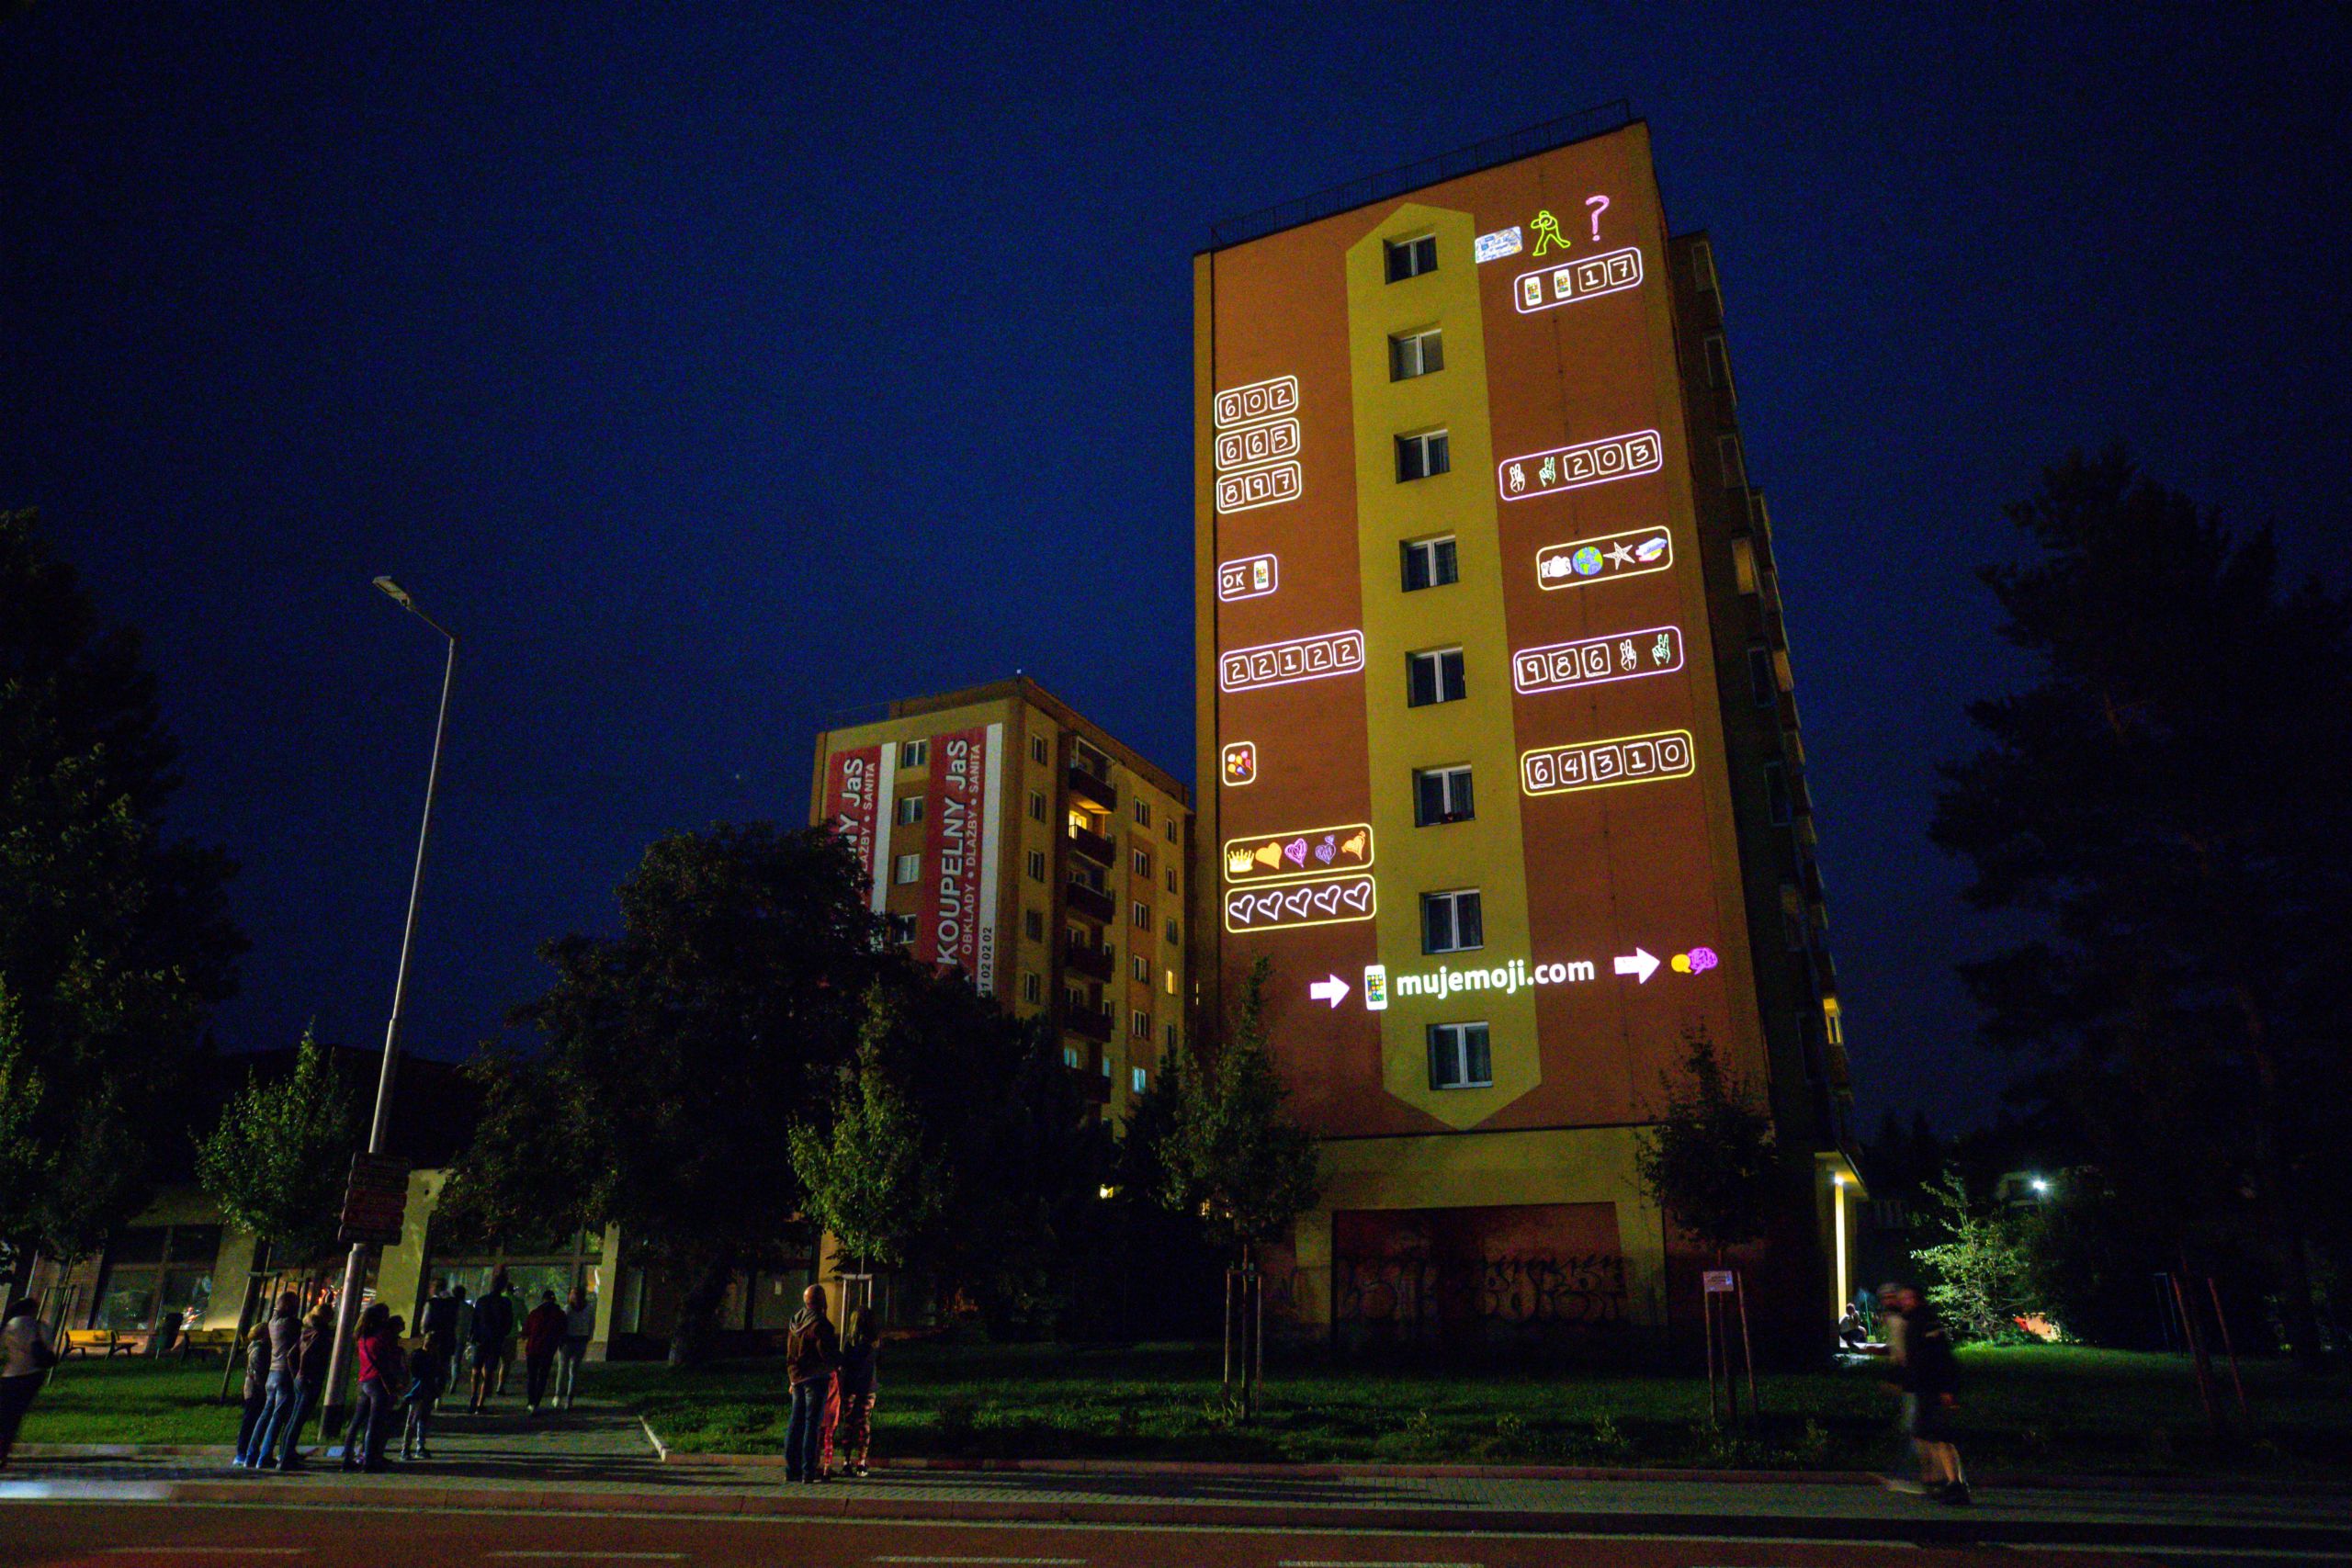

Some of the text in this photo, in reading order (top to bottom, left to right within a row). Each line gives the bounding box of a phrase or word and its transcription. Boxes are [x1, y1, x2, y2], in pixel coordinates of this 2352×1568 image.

[1584, 260, 1628, 286] 17
[1224, 388, 1290, 417] 602
[1225, 429, 1289, 459] 665
[1572, 444, 1649, 475] 203
[1225, 471, 1290, 503] 897
[1223, 571, 1244, 588] OK
[1231, 643, 1358, 680] 22122
[1526, 649, 1604, 682] 986
[1534, 743, 1679, 782] 64310
[841, 757, 865, 807] JaS
[863, 762, 876, 810] SANITA
[936, 739, 968, 965] KOUPELNY JaS
[962, 883, 975, 954] OBKLADY
[969, 744, 980, 793] SANITA
[982, 927, 992, 942] 02
[981, 945, 991, 961] 02
[980, 964, 990, 978] 02
[1396, 958, 1595, 999] mujemoji.com
